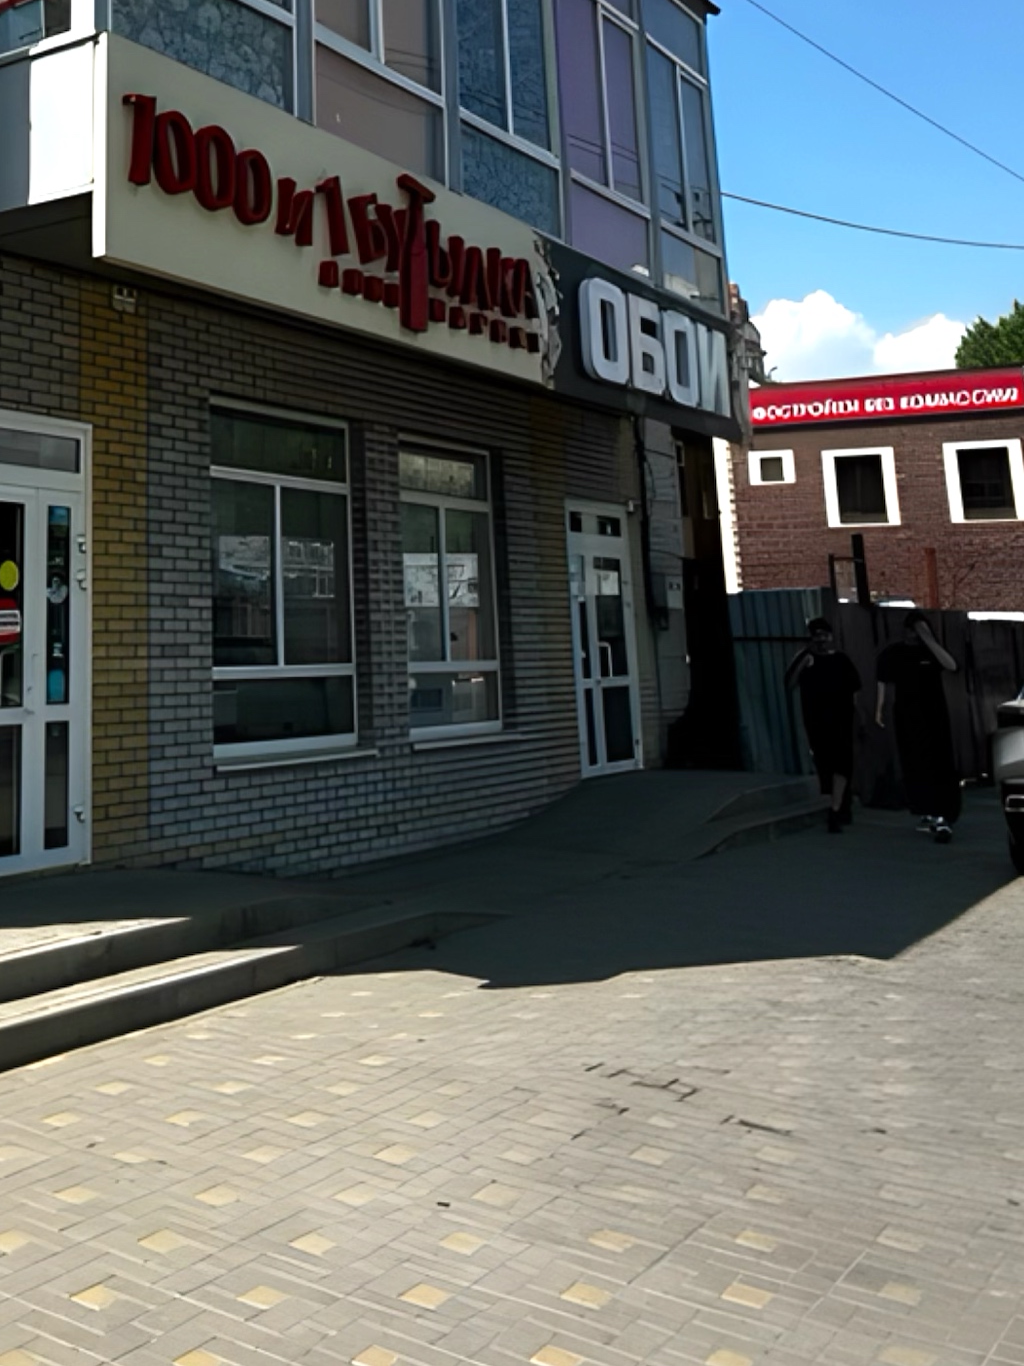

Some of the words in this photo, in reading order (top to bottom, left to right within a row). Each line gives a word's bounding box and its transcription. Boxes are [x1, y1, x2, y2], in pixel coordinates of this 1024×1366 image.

[122, 93, 272, 226] 1000
[315, 175, 351, 257] 1
[347, 173, 540, 333] БУТЫЛКА
[578, 277, 732, 418] ОБОИ
